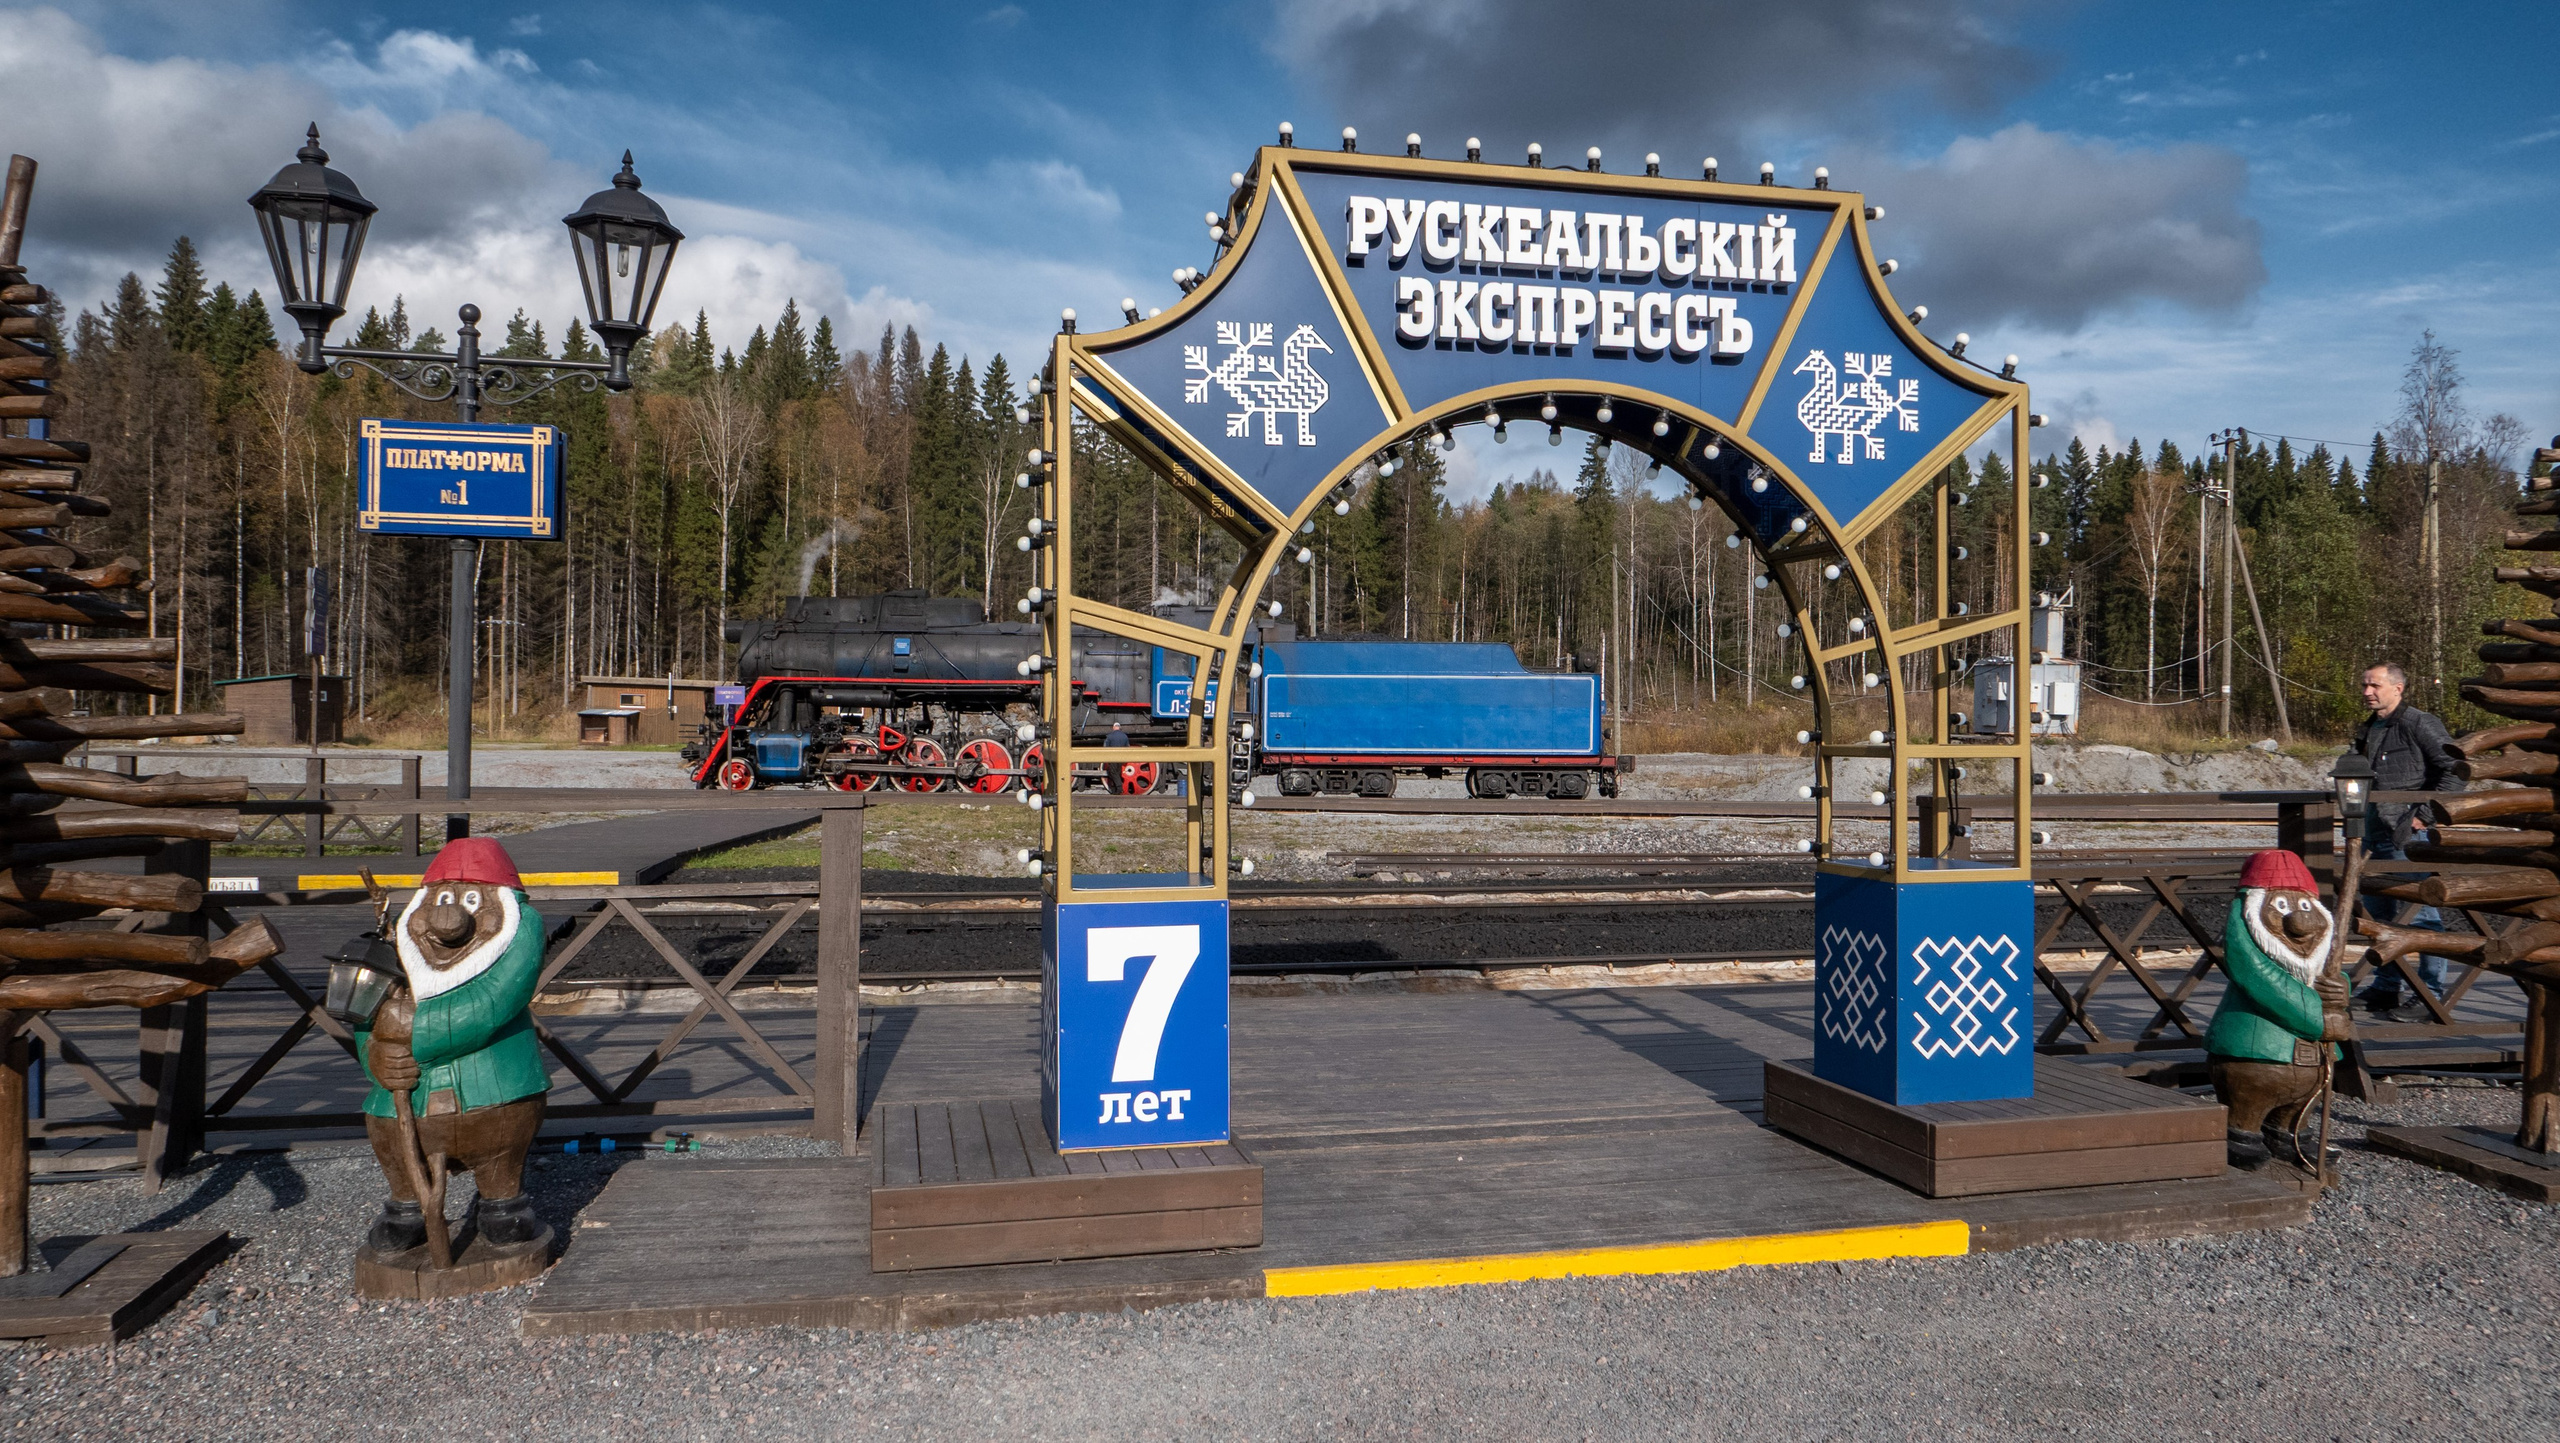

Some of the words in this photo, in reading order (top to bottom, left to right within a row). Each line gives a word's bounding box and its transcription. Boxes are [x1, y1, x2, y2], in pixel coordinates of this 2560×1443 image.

[1346, 196, 1797, 286] РУСКЕАЛЬСКІЙ
[1396, 276, 1753, 356] ЭКСПРЕССЪ
[386, 448, 525, 473] ПЛАТФОРМА
[440, 480, 468, 505] №1
[1087, 925, 1200, 1083] 7
[1099, 1090, 1191, 1124] лет
